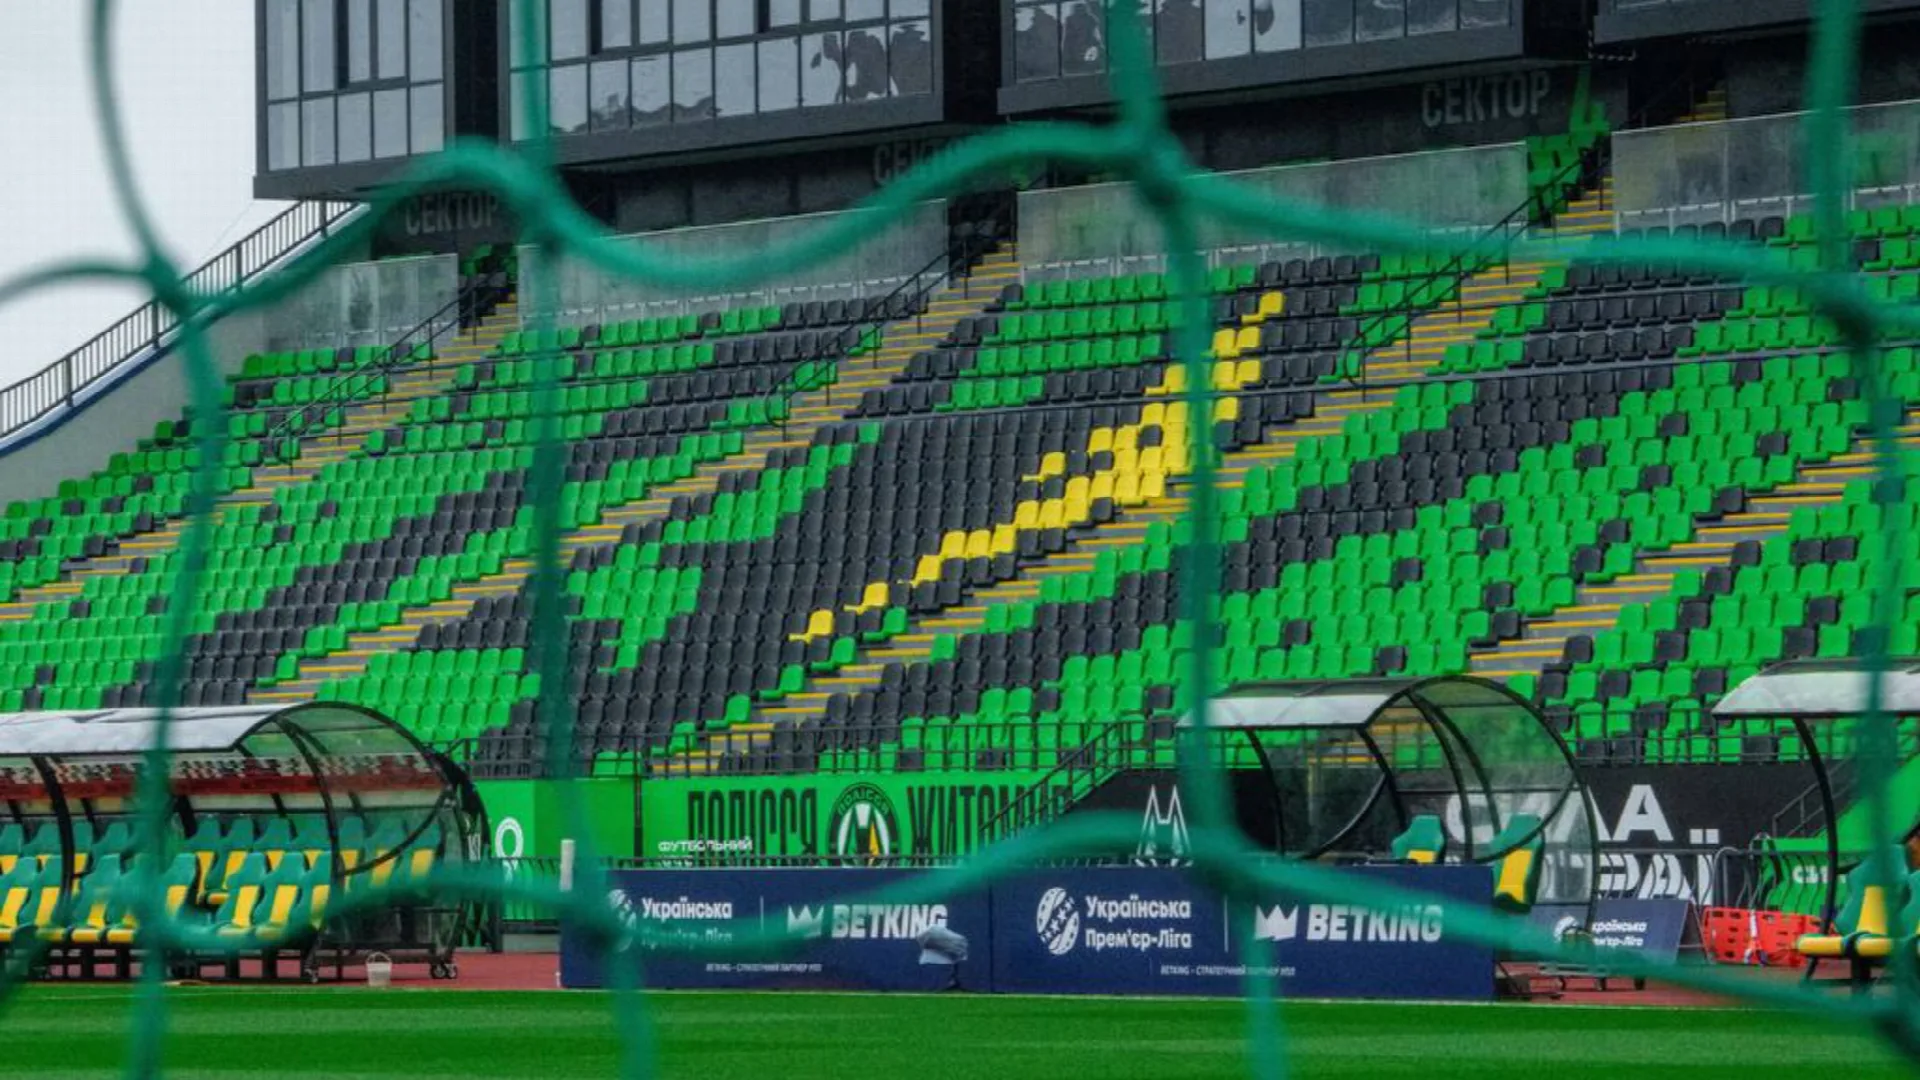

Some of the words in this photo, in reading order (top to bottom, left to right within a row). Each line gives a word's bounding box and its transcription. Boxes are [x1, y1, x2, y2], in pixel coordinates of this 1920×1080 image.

[1421, 70, 1550, 128] СЕКТОР
[641, 895, 733, 922] Українська
[831, 904, 947, 939] BETKING
[1085, 894, 1192, 923] Українська
[1306, 904, 1444, 942] BETKING
[1085, 928, 1192, 952] Прем'єр-Ліга
